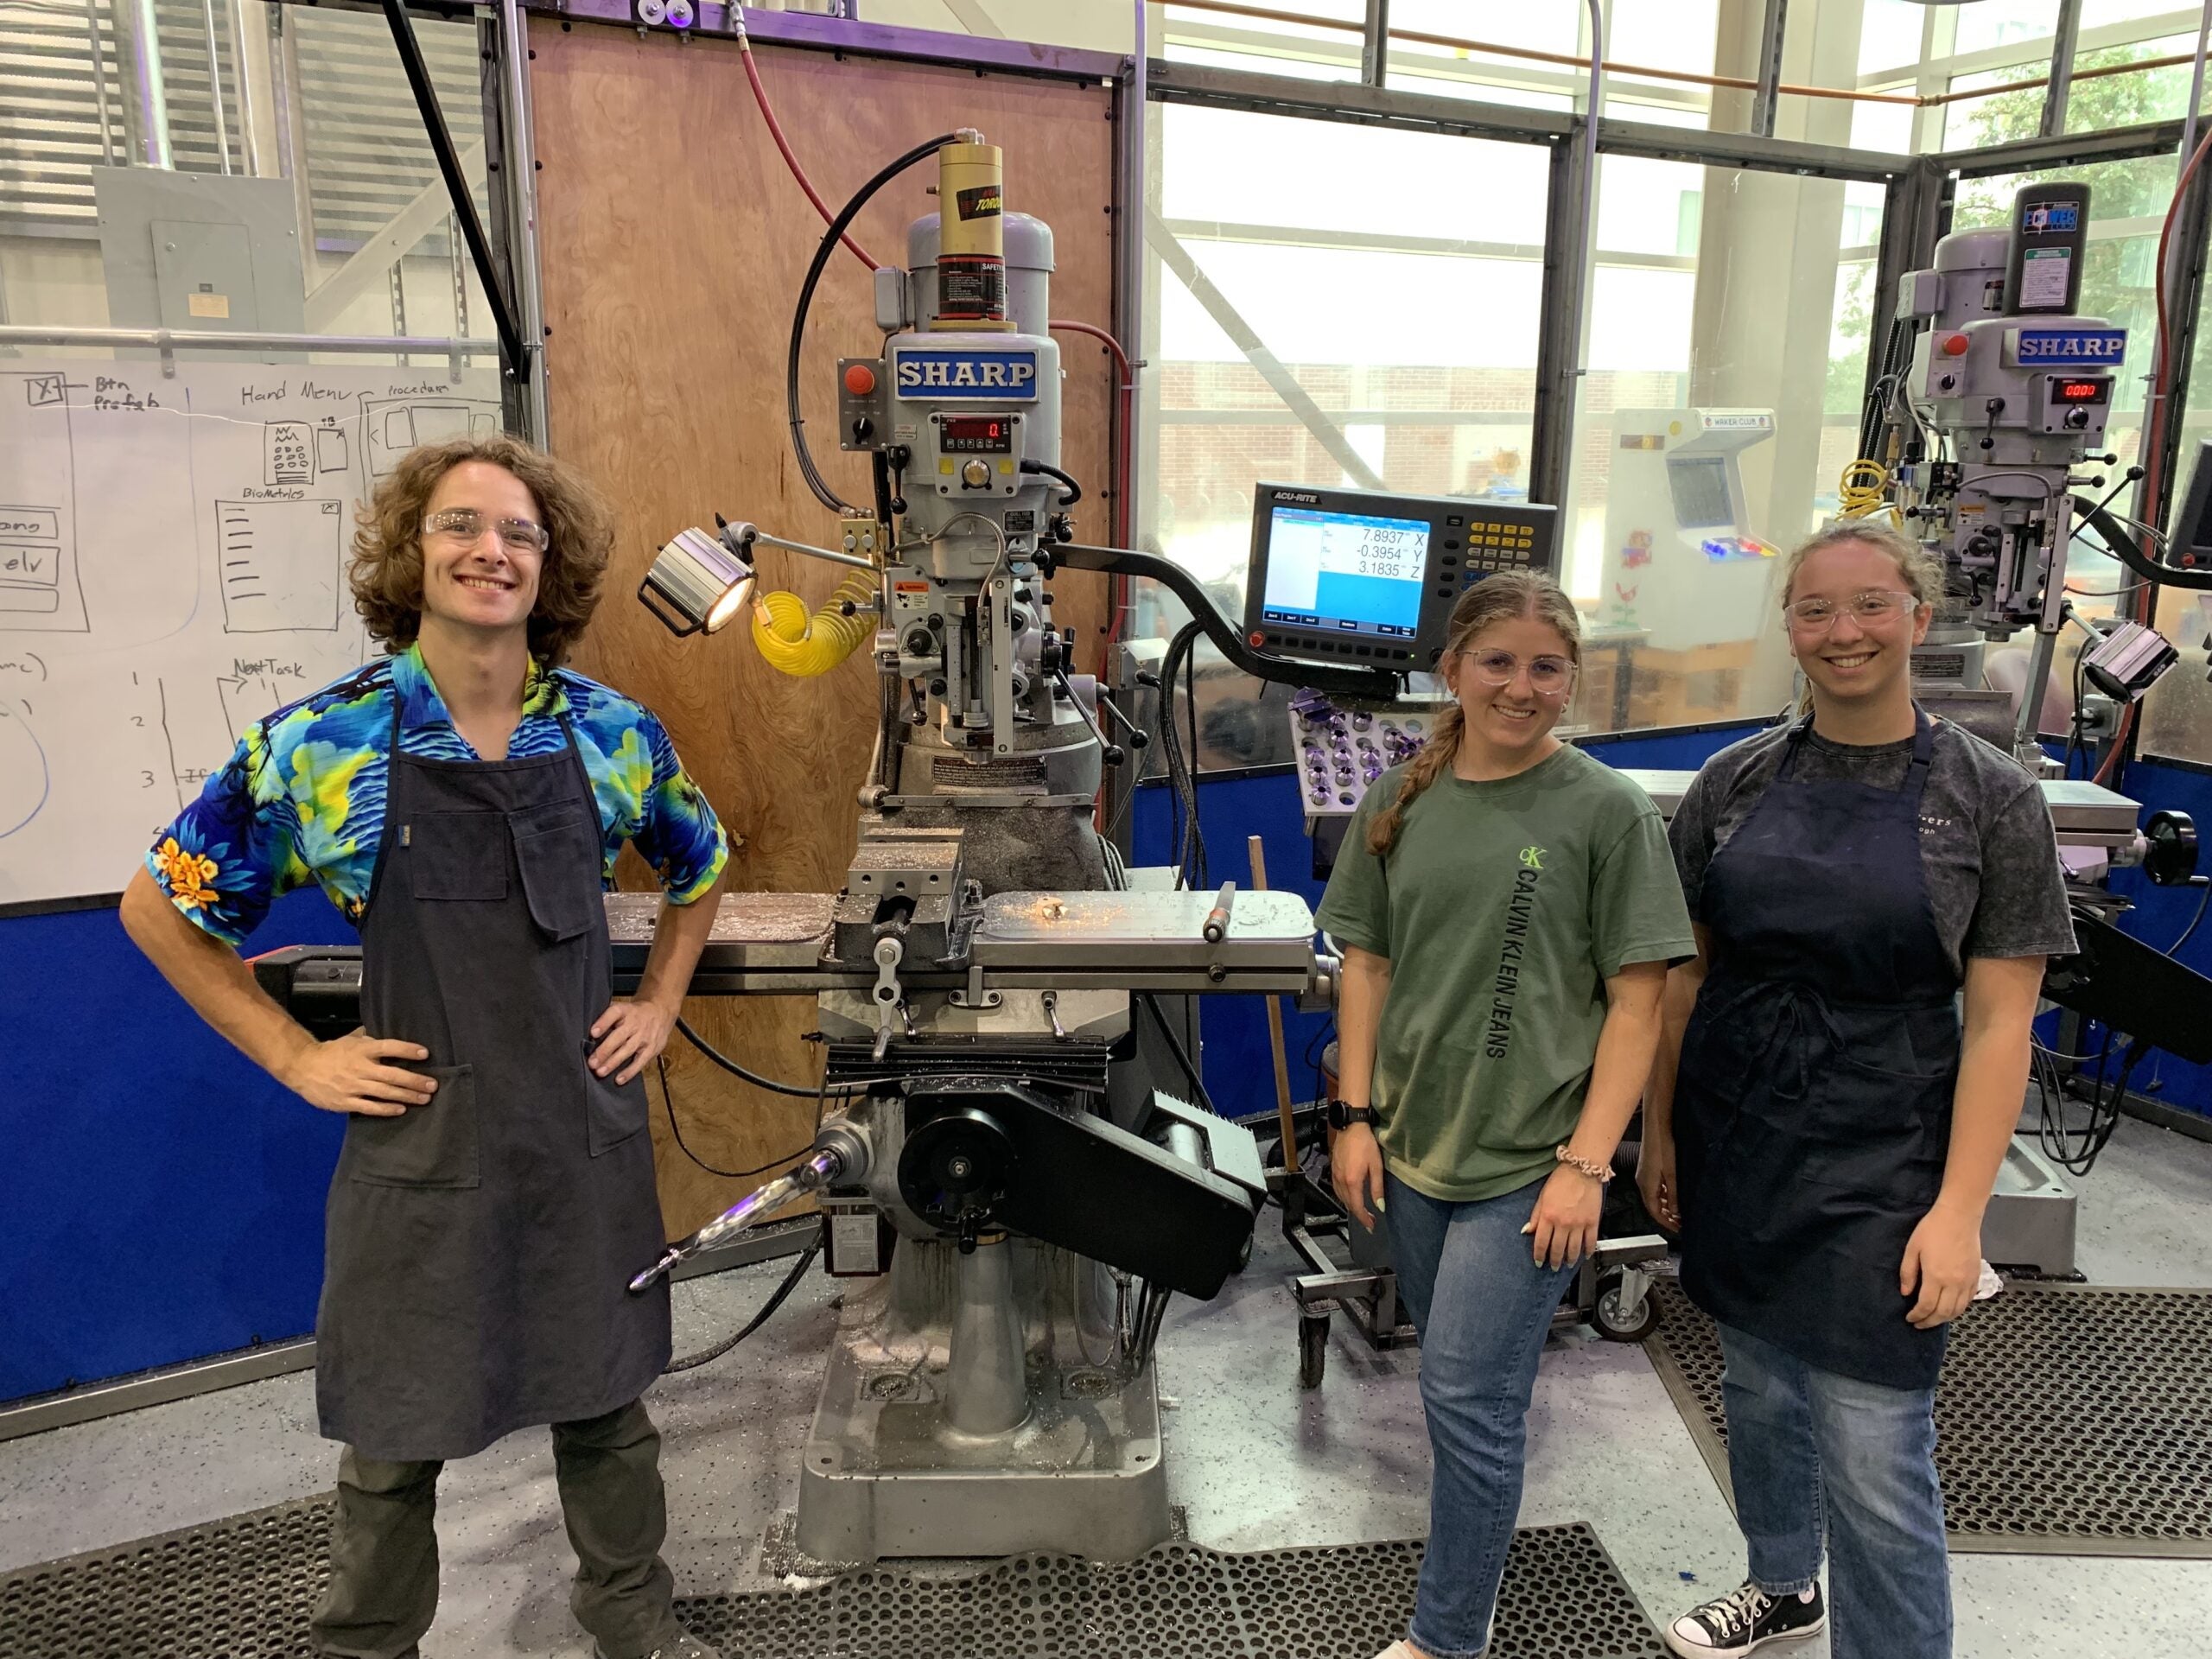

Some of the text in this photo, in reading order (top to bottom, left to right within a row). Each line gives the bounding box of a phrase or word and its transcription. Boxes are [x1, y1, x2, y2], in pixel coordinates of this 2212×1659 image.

[2020, 338, 2124, 356] SHARP
[899, 361, 1034, 387] SHARP
[242, 381, 287, 405] Hand
[1274, 491, 1318, 504] ACU-RITE
[1363, 528, 1425, 547] 7.8937 X
[1357, 544, 1423, 563] -0.3954 Y
[1358, 561, 1420, 579] 3.1835 Z
[130, 716, 145, 727] 2
[141, 771, 155, 788] 3
[1485, 868, 1539, 1059] CALVIN KLEIN JEANS
